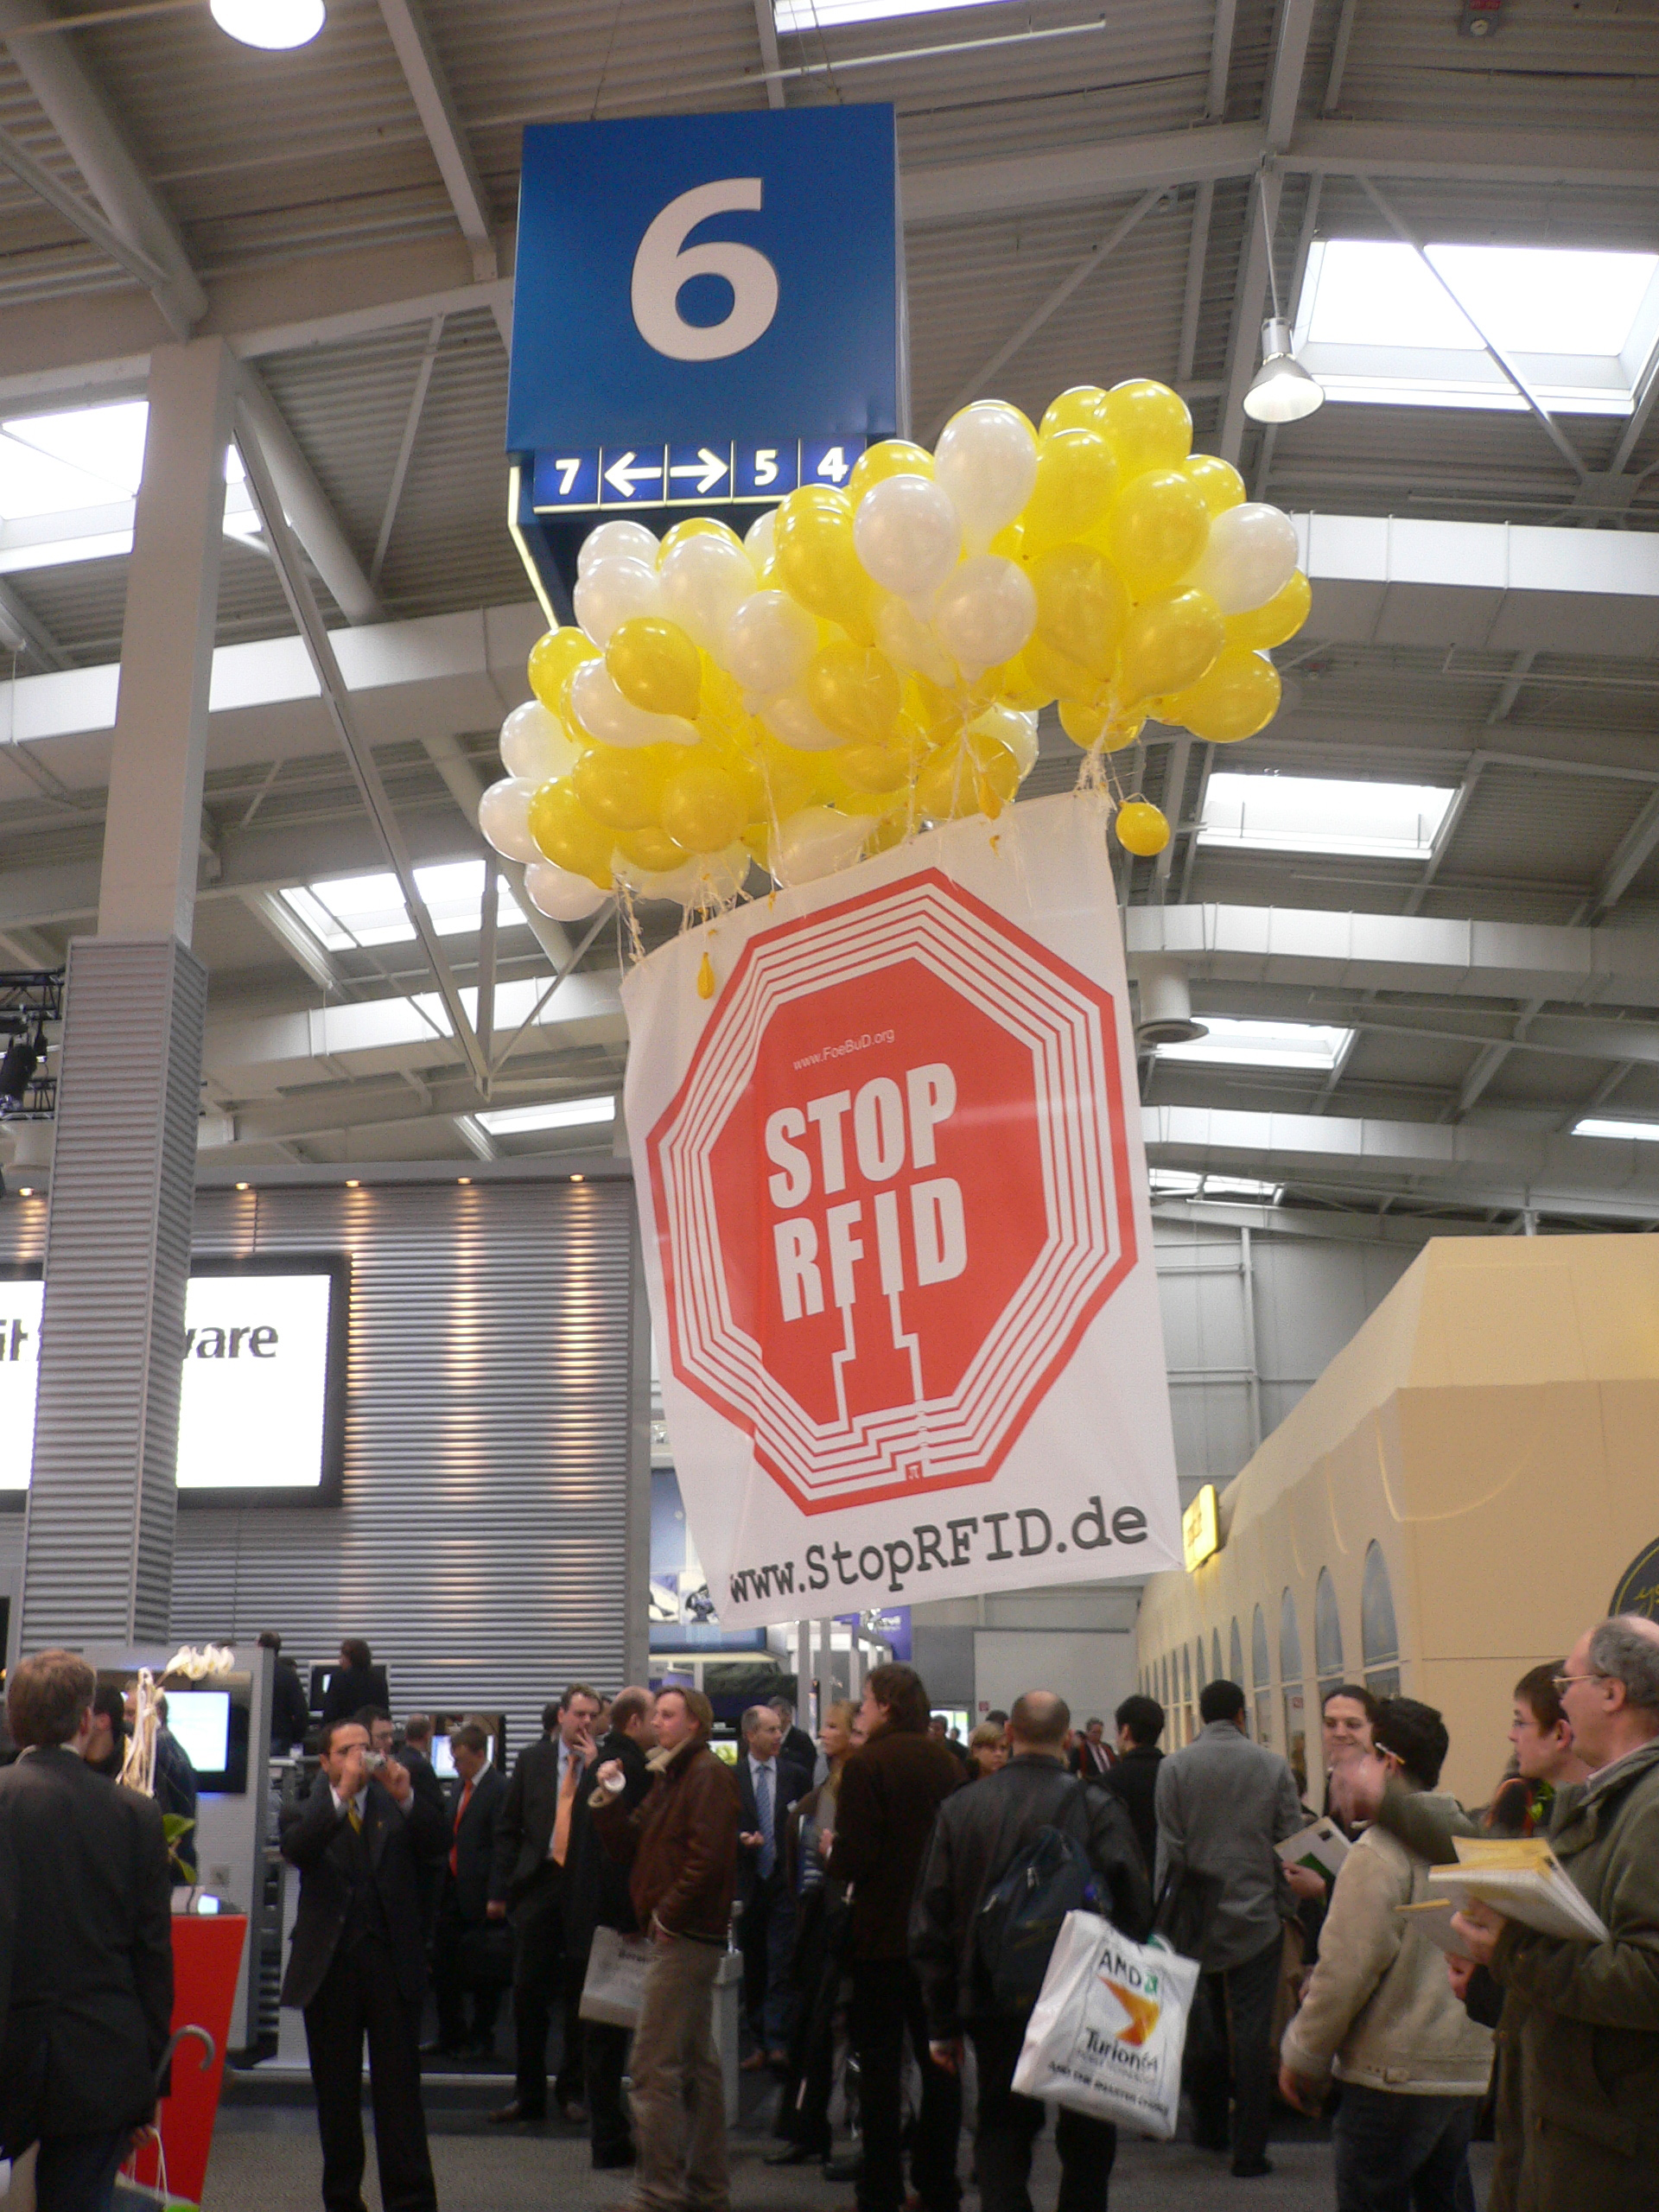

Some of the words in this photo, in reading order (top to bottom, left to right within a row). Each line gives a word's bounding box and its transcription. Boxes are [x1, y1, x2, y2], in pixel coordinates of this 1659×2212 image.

[631, 177, 779, 362] 6
[556, 458, 582, 495] 7
[753, 448, 779, 486] 5
[817, 447, 849, 482] 4
[792, 1028, 895, 1071] www.FoeBuD.org
[765, 1063, 957, 1209] STOP
[772, 1177, 968, 1322] RFID
[729, 1495, 1148, 1604] www.StopRFID.de
[1097, 1948, 1142, 1987] AMD
